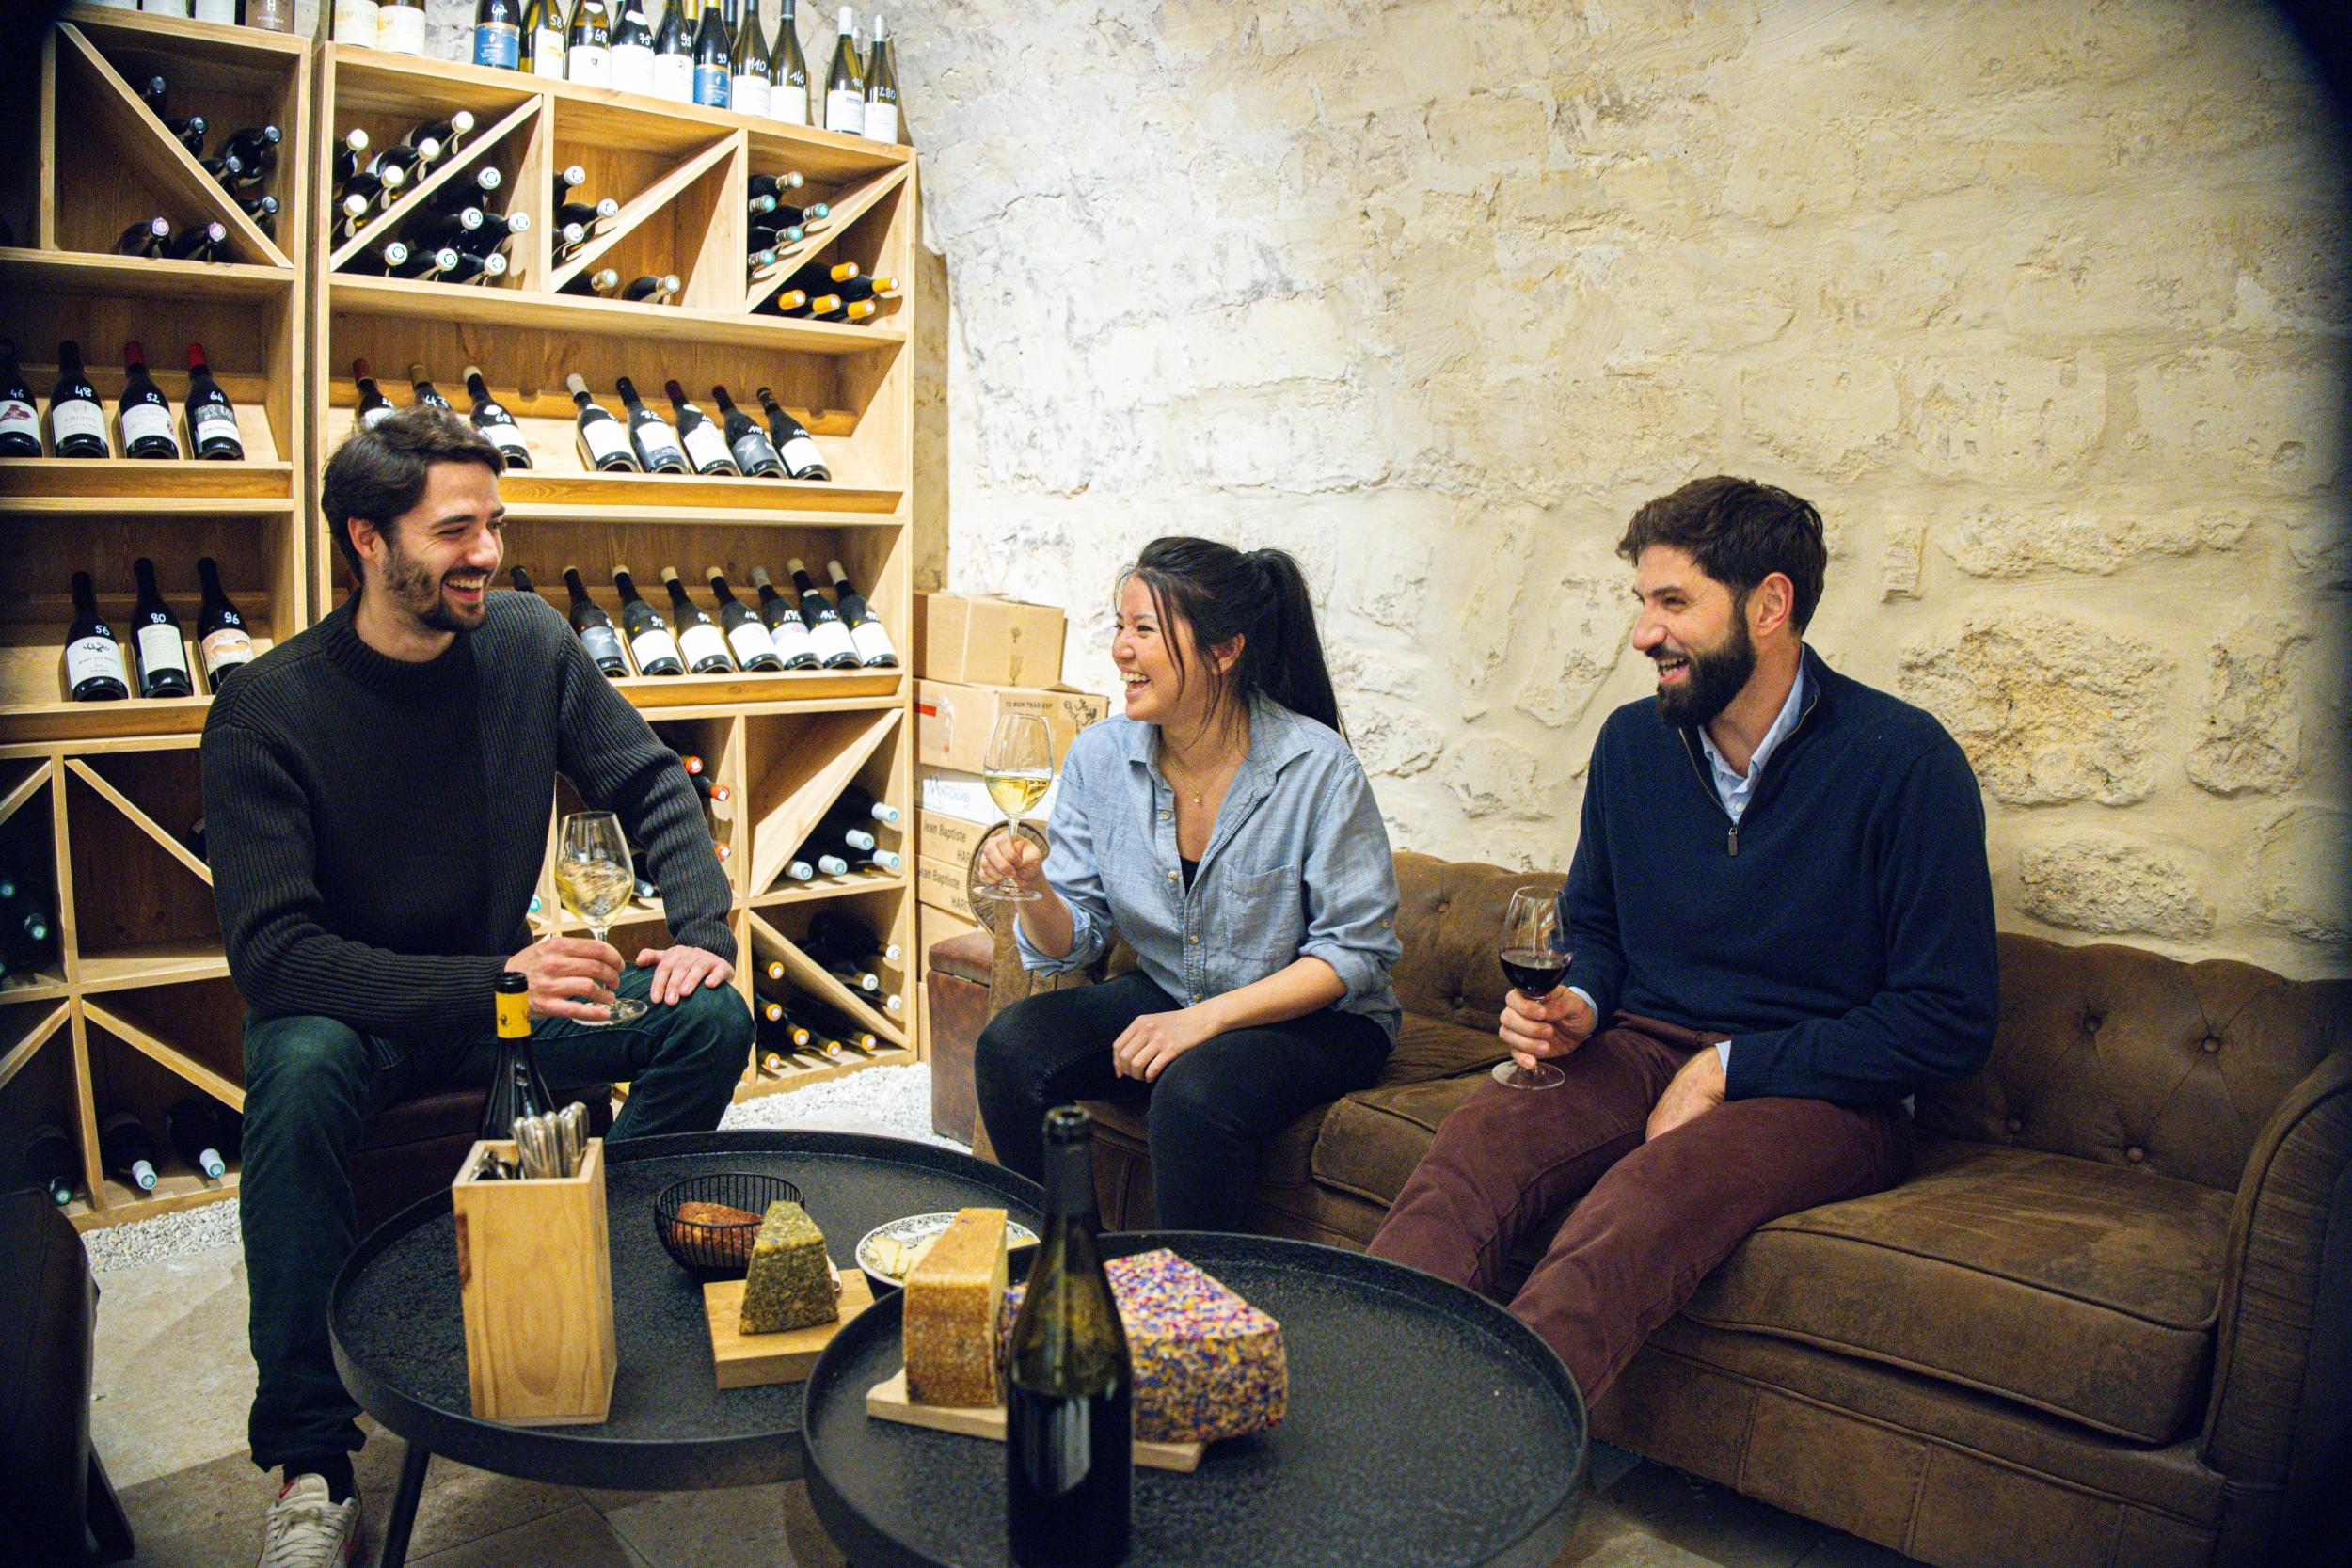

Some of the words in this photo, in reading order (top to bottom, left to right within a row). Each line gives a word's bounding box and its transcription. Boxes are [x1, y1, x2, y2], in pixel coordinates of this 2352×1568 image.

[550, 14, 563, 27] 58
[595, 29, 608, 43] 68
[681, 32, 691, 47] 95
[717, 53, 727, 64] 99
[747, 57, 766, 72] 110
[790, 70, 804, 85] 140
[879, 87, 896, 100] 280
[10, 389, 24, 398] 46
[75, 385, 92, 398] 48
[146, 392, 160, 404] 52
[210, 391, 224, 403] 64
[496, 413, 512, 423] 68
[151, 612, 166, 624] 80
[224, 611, 240, 625] 96
[95, 625, 110, 636] 56
[924, 820, 938, 832] Jean
[939, 823, 967, 843] Baptiste
[932, 870, 960, 890] Baptiste
